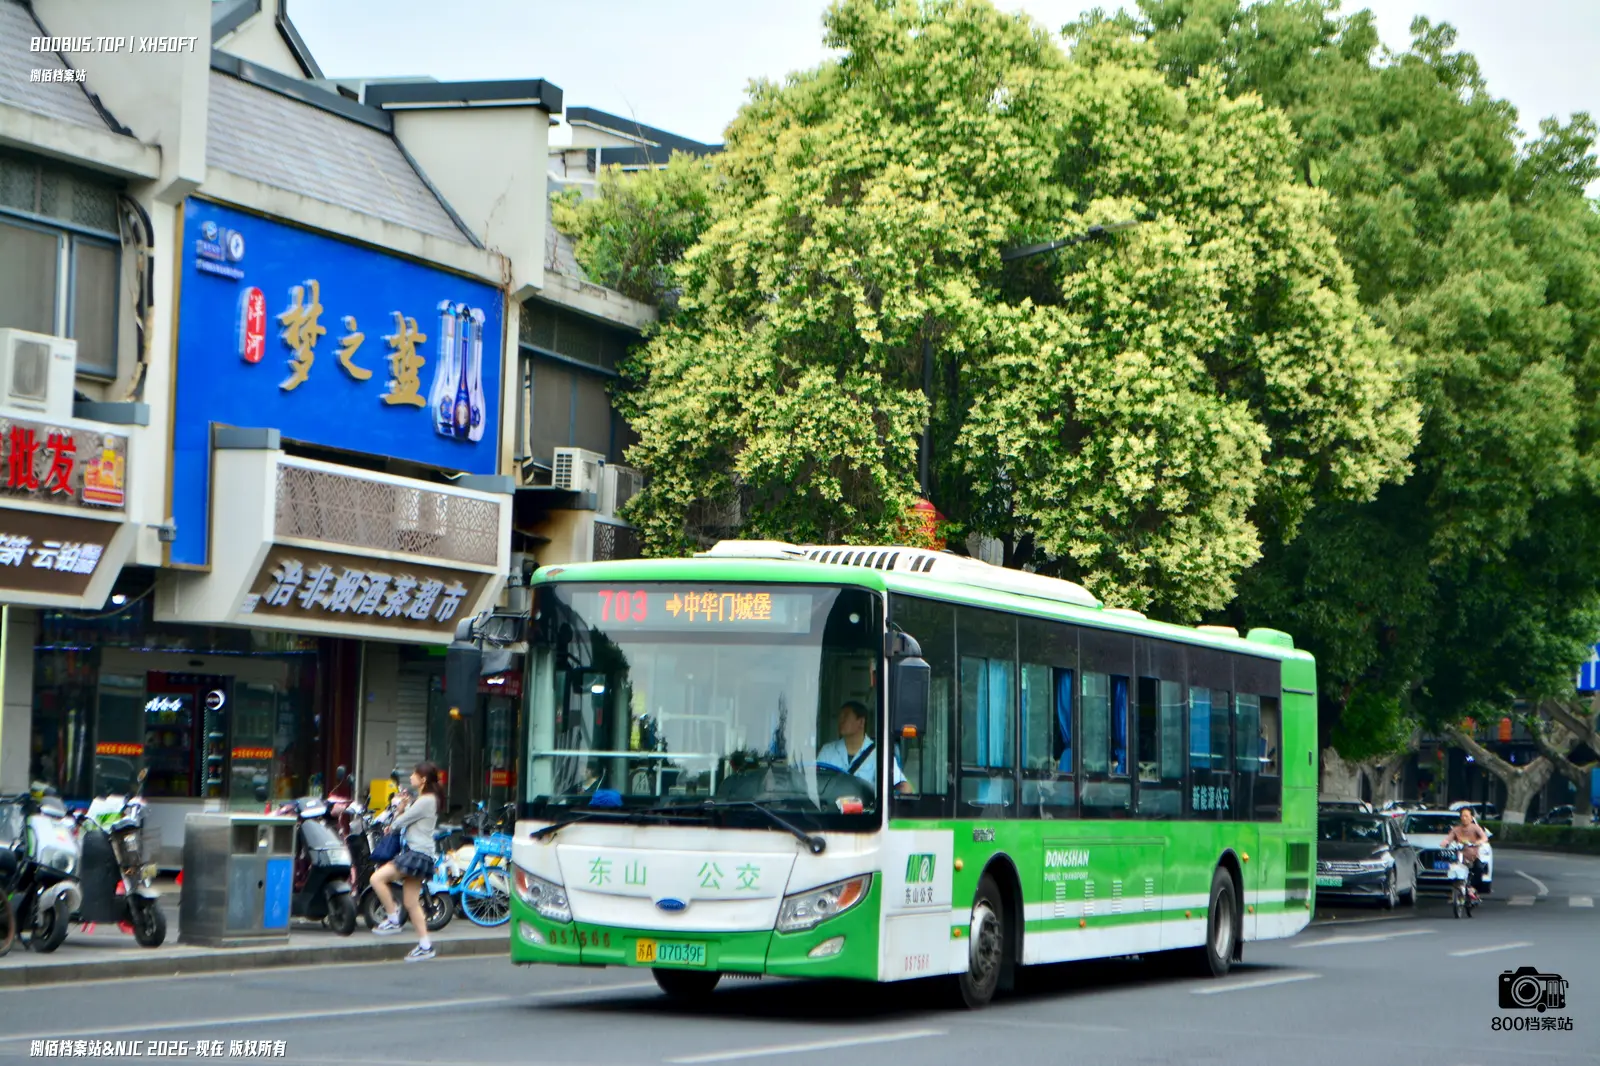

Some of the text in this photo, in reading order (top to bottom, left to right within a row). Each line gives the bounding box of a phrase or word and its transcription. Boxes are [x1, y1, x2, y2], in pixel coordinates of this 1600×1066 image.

[276, 279, 428, 408] 梦之蓝
[0, 425, 77, 497] 批发
[598, 589, 772, 622] 703 中华门城堡
[1192, 784, 1230, 811] 新能源公交
[1045, 849, 1090, 868] DONGSHAN
[1044, 871, 1089, 883] PUBLIC TRANSPORT
[905, 886, 934, 905] 东山公交
[659, 944, 705, 962] 07039F
